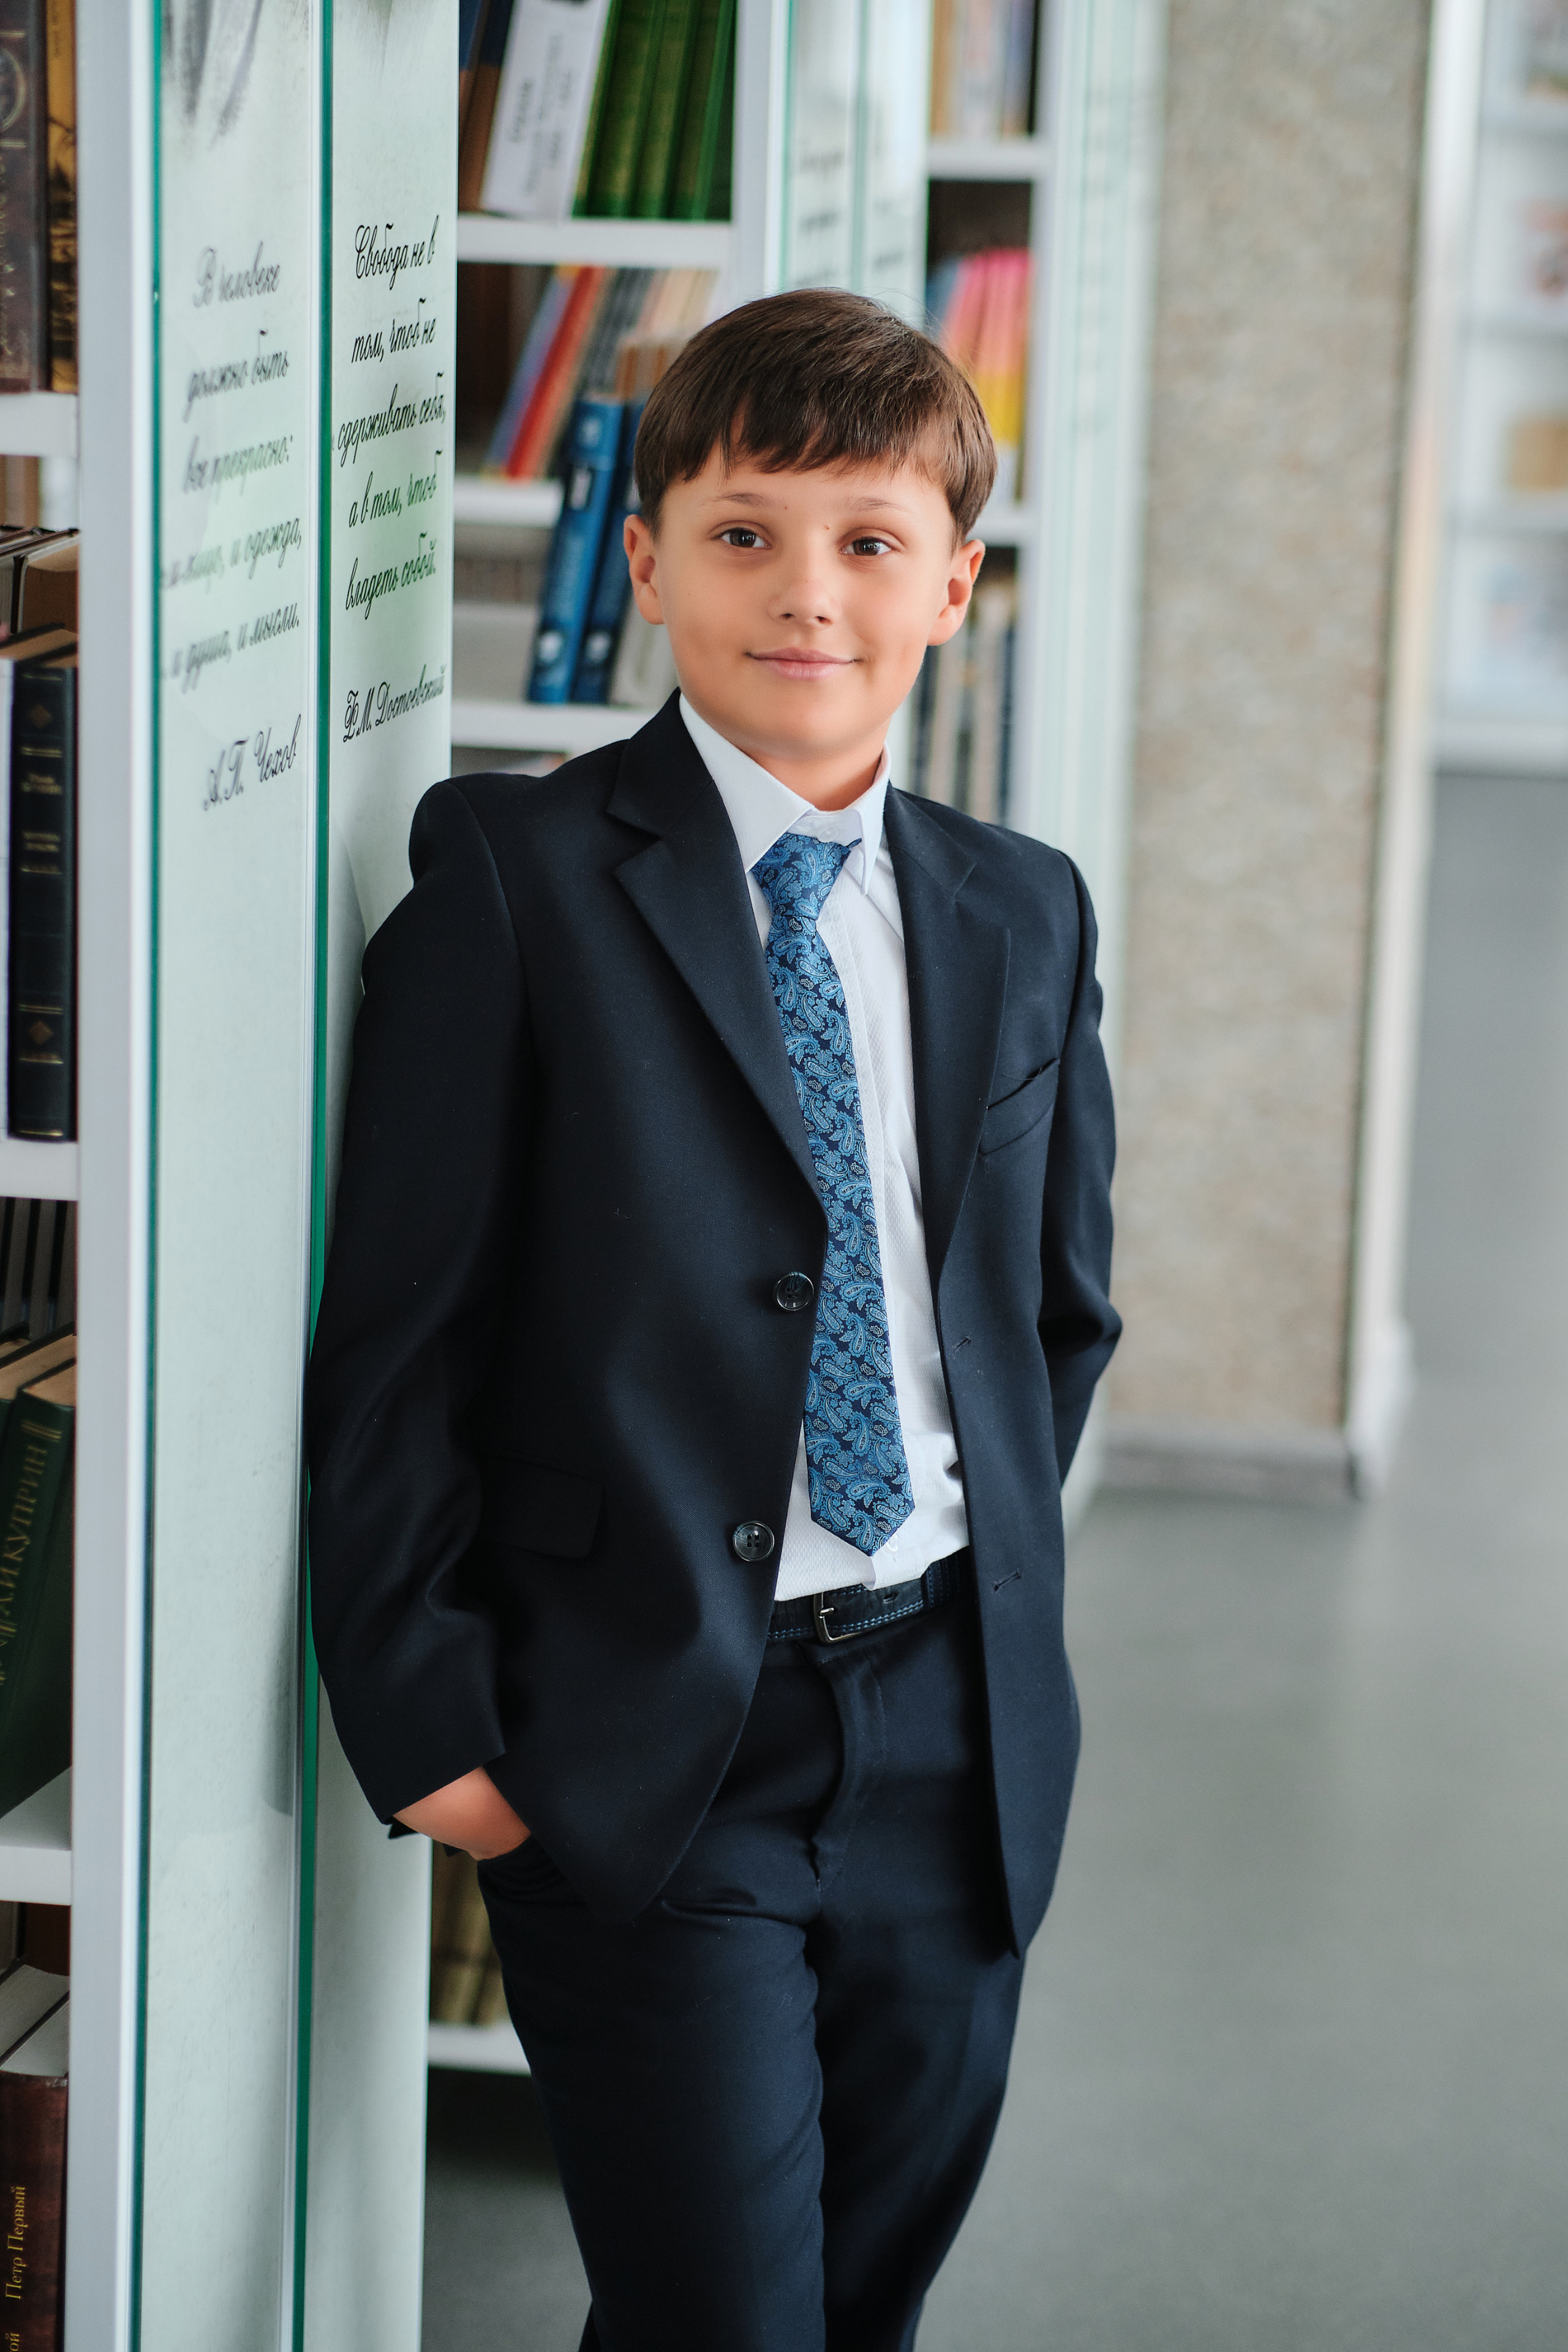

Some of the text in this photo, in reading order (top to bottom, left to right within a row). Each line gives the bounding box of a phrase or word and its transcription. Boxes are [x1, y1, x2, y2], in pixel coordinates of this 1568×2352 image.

[192, 240, 280, 307] В человеке
[355, 214, 439, 290] Свобода не в
[351, 297, 437, 363] том, чтоб не
[183, 329, 290, 424] должно быть
[337, 372, 447, 467] сдерживать себя,
[210, 434, 293, 505] прекрасно:
[349, 500, 359, 528] а
[360, 470, 373, 524] в
[370, 486, 402, 518] том,
[244, 517, 302, 580] одежда,
[346, 531, 437, 620] владеть собой.
[182, 629, 232, 695] душа,
[237, 622, 248, 652] и
[249, 602, 300, 647] мысли.
[375, 663, 448, 727] Достоевский
[254, 713, 301, 783] Чехов
[5, 2185, 29, 2301] Петр Первый
